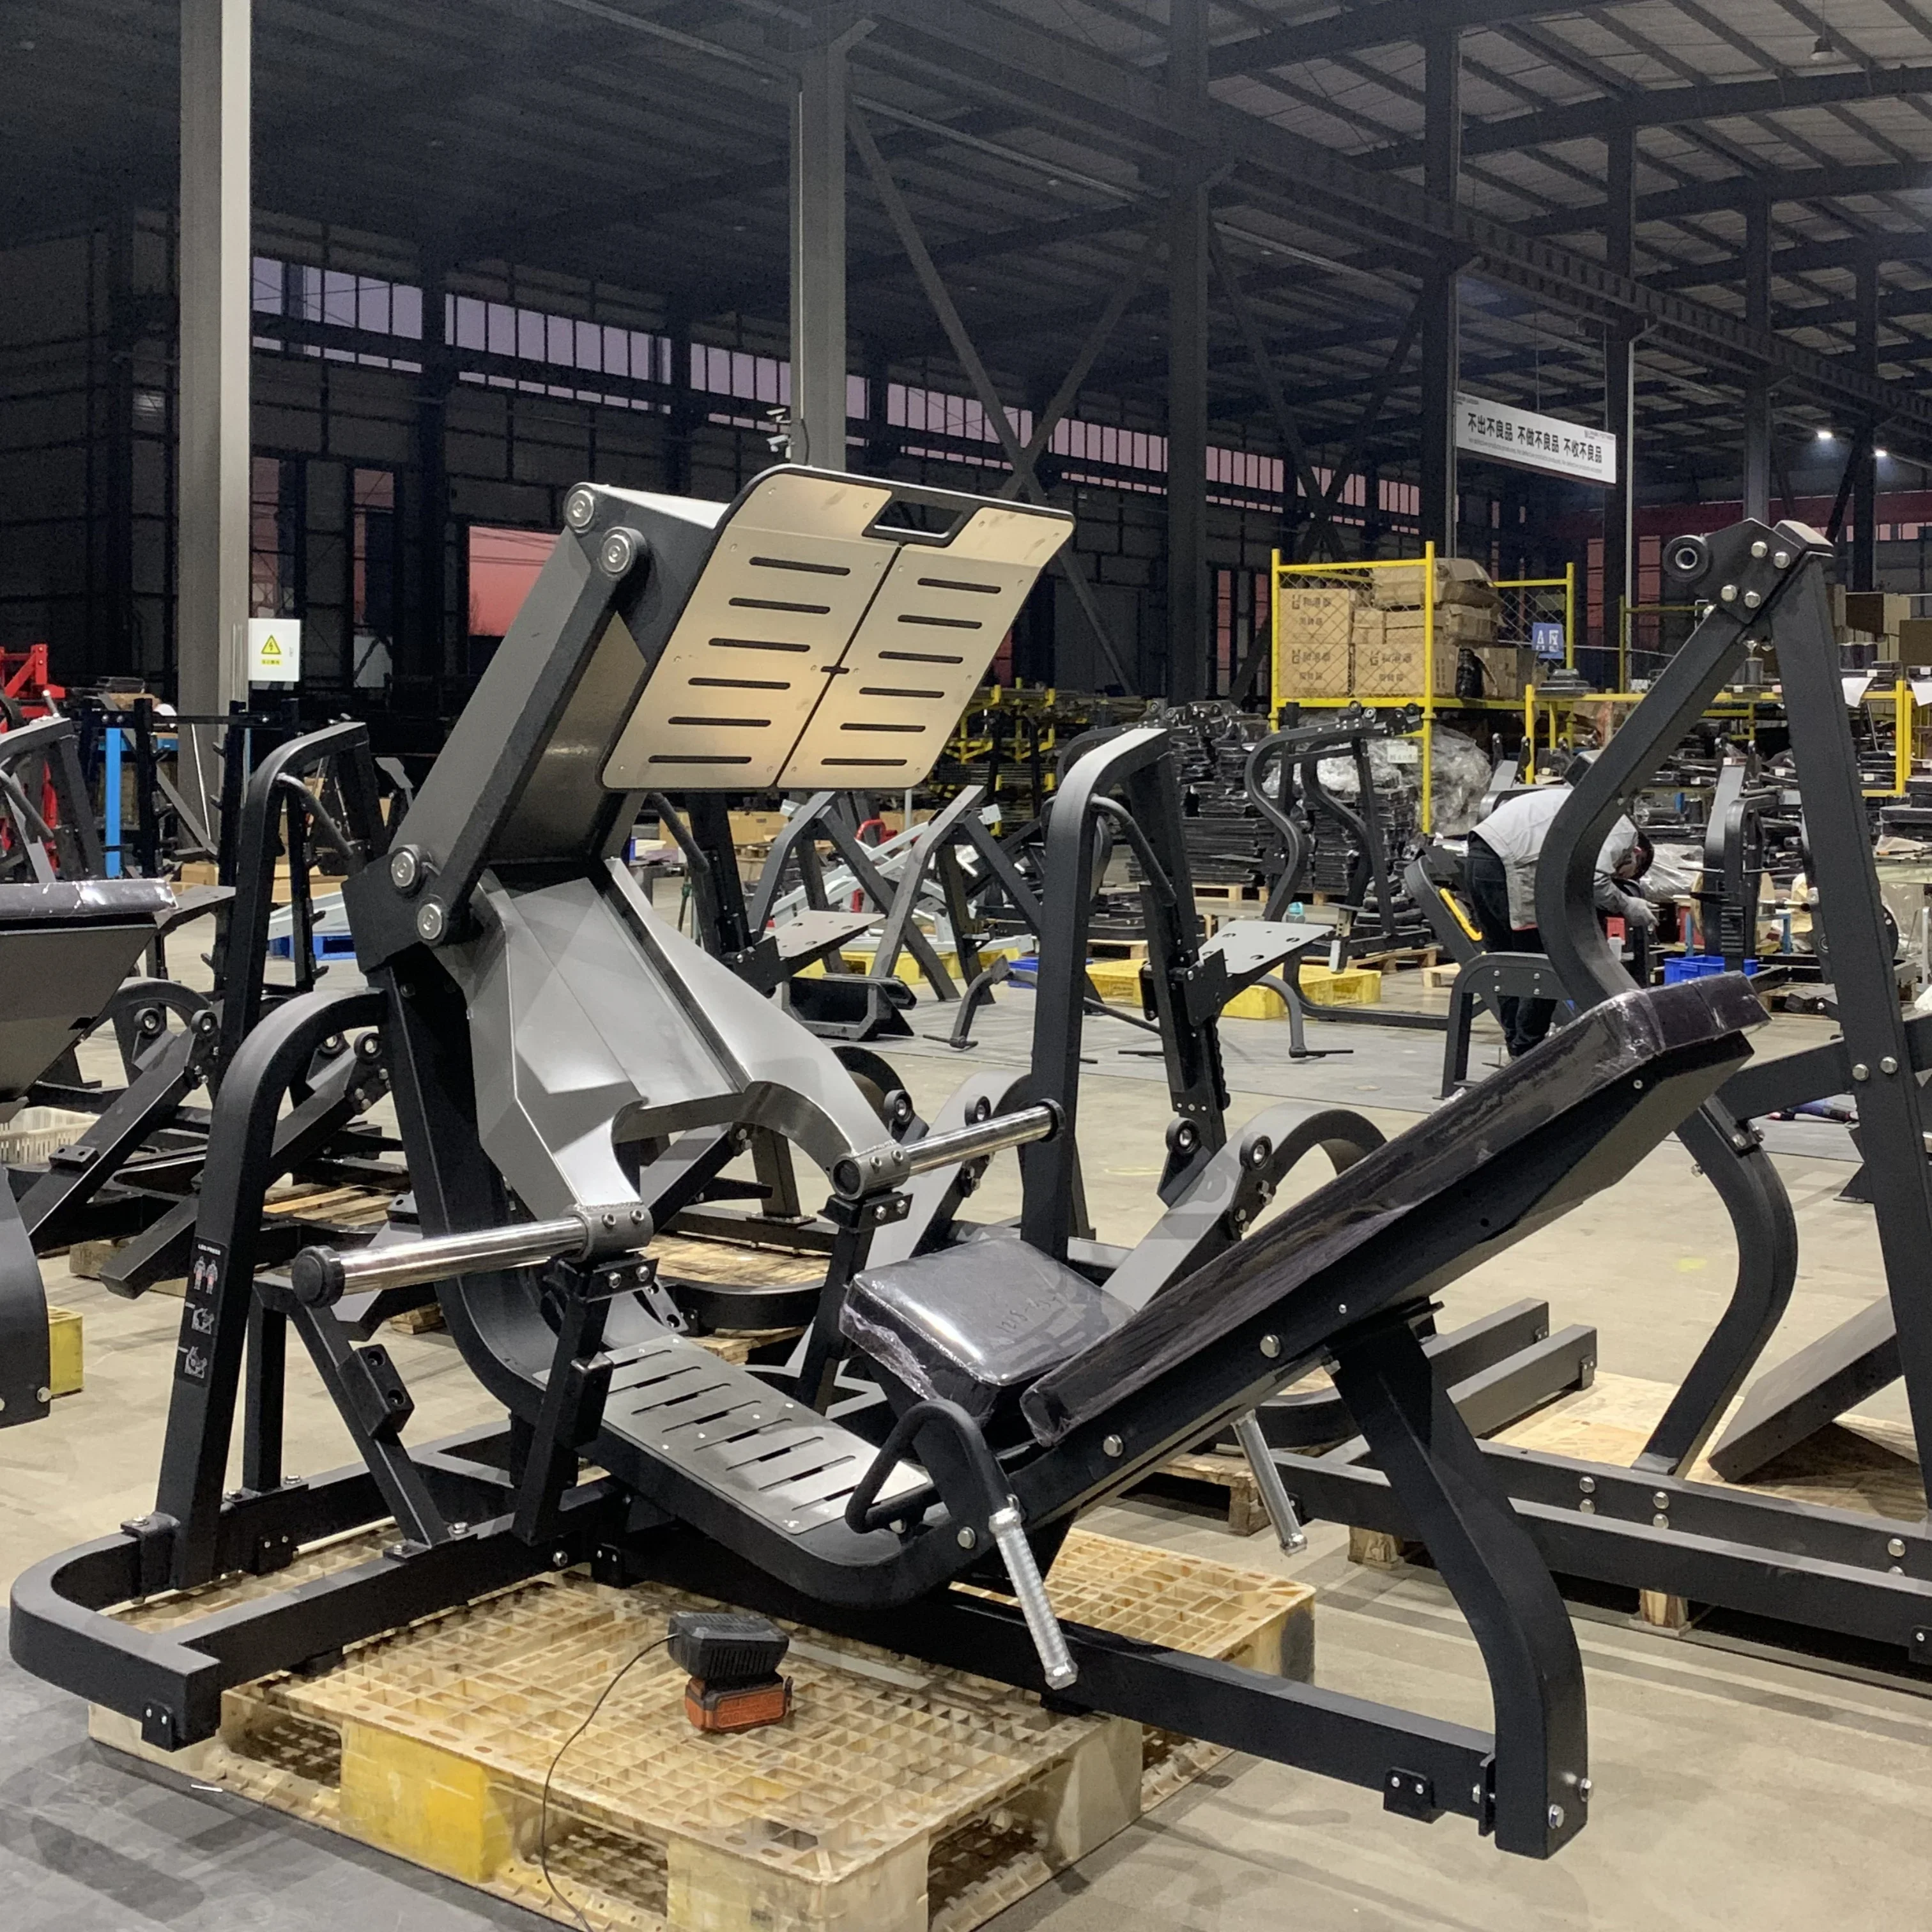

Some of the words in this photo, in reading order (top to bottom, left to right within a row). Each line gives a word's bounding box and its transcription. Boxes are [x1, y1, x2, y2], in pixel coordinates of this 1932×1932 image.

[1468, 412, 1513, 441] 不出不良品
[1517, 425, 1560, 453] 不做不良品
[1563, 438, 1602, 463] 不收不良品
